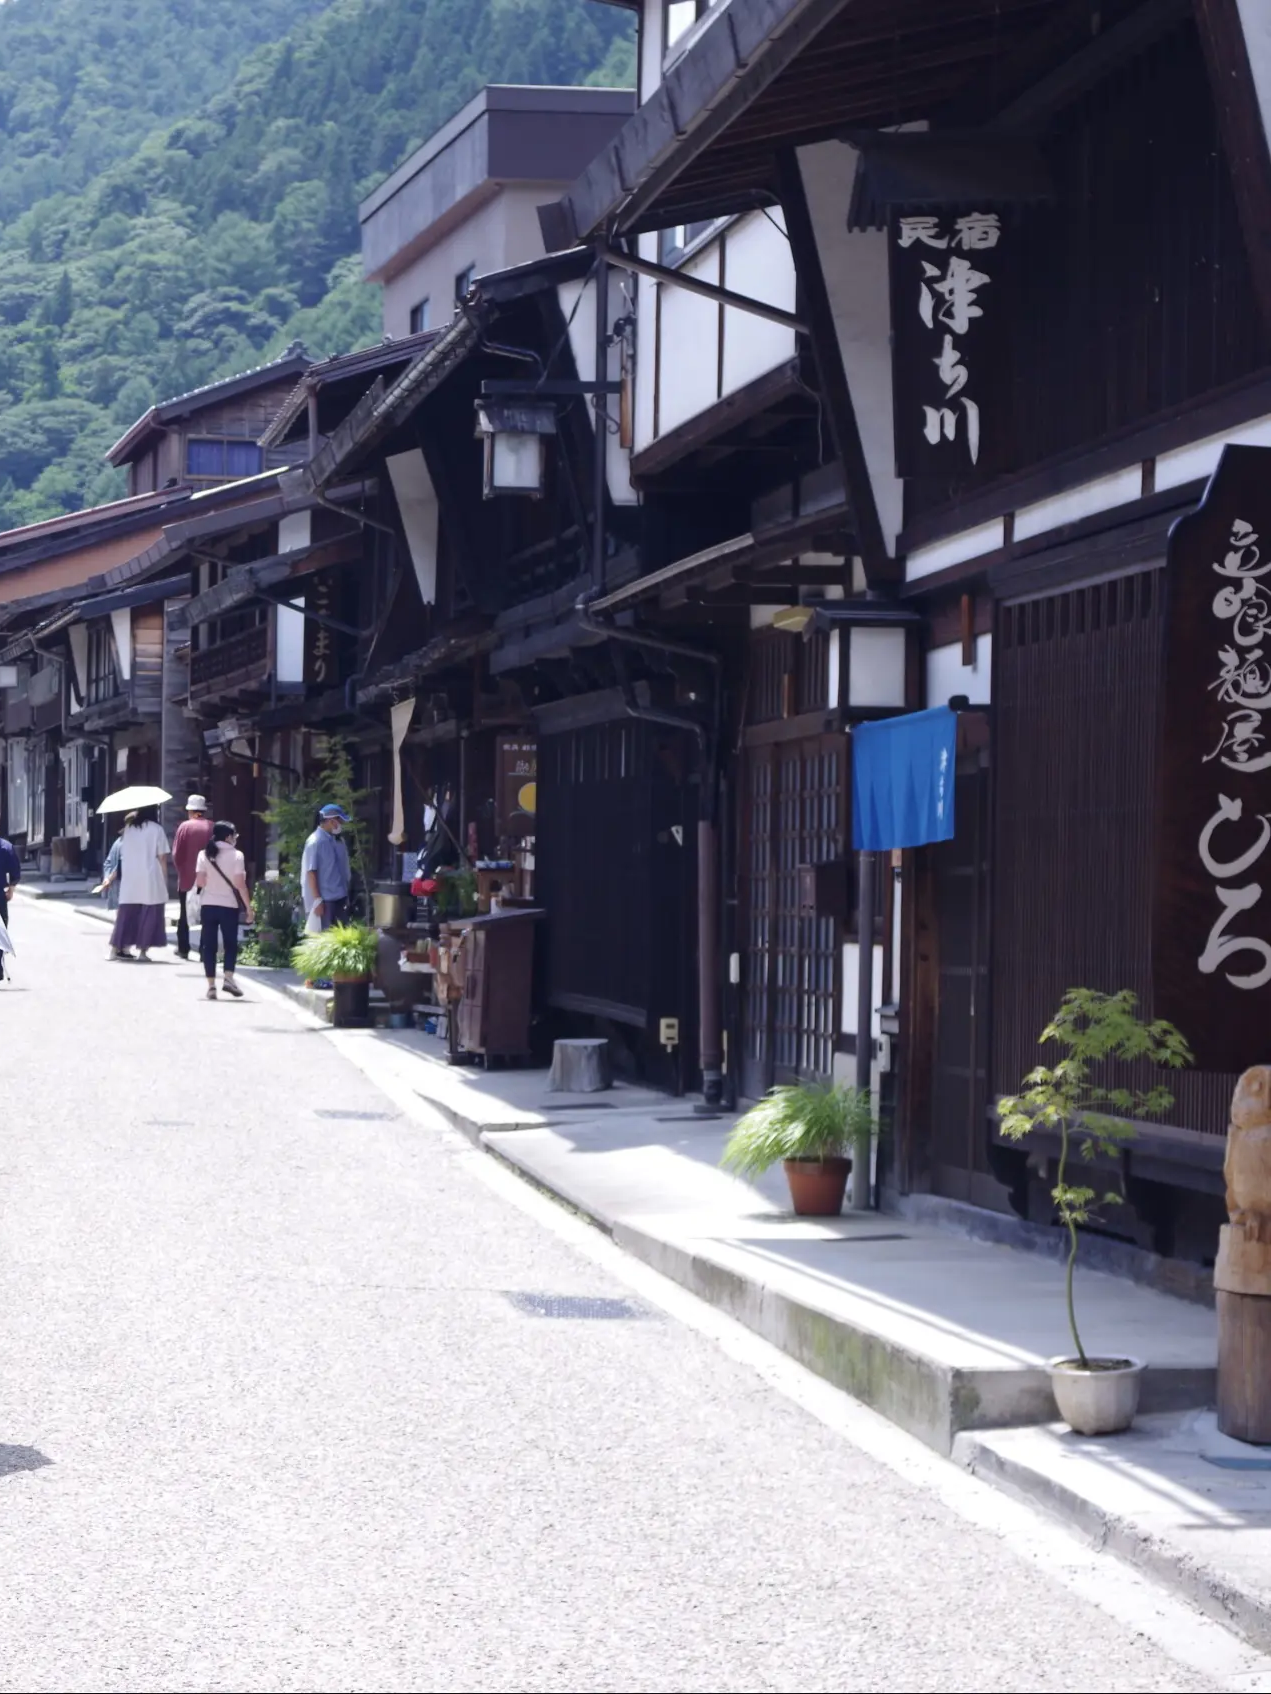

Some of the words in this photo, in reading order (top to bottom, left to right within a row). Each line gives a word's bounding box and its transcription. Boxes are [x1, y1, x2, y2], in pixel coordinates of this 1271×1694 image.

[897, 212, 1002, 251] 民宿
[918, 255, 993, 467] 津ち川
